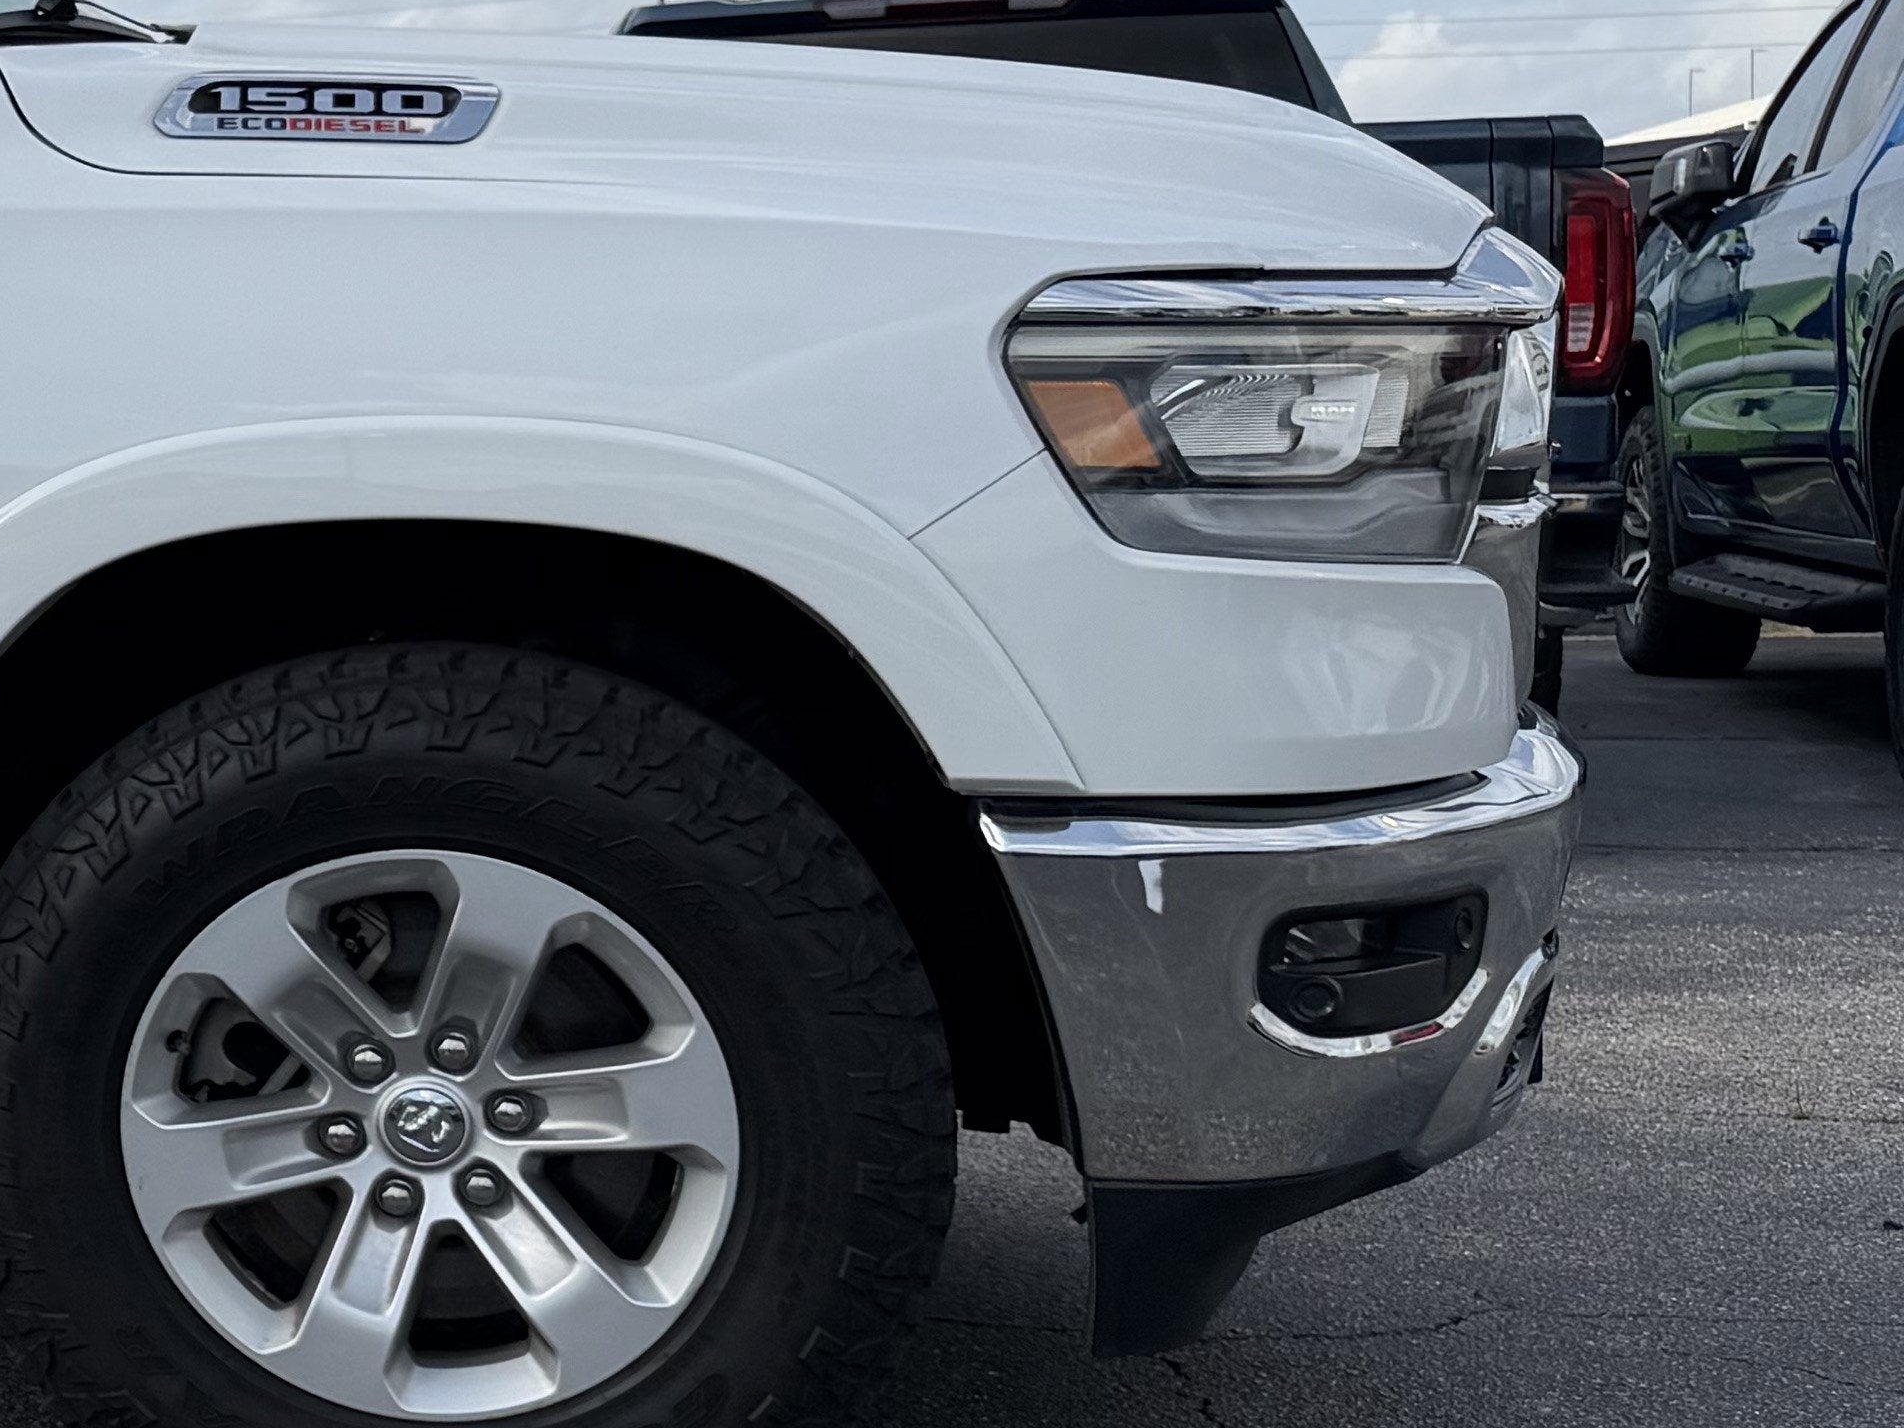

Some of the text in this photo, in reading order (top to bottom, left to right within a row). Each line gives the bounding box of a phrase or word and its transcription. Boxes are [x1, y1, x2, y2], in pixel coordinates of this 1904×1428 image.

[210, 85, 445, 115] 1500
[216, 118, 426, 134] ECODIESEL
[126, 771, 745, 940] WRANGLER
